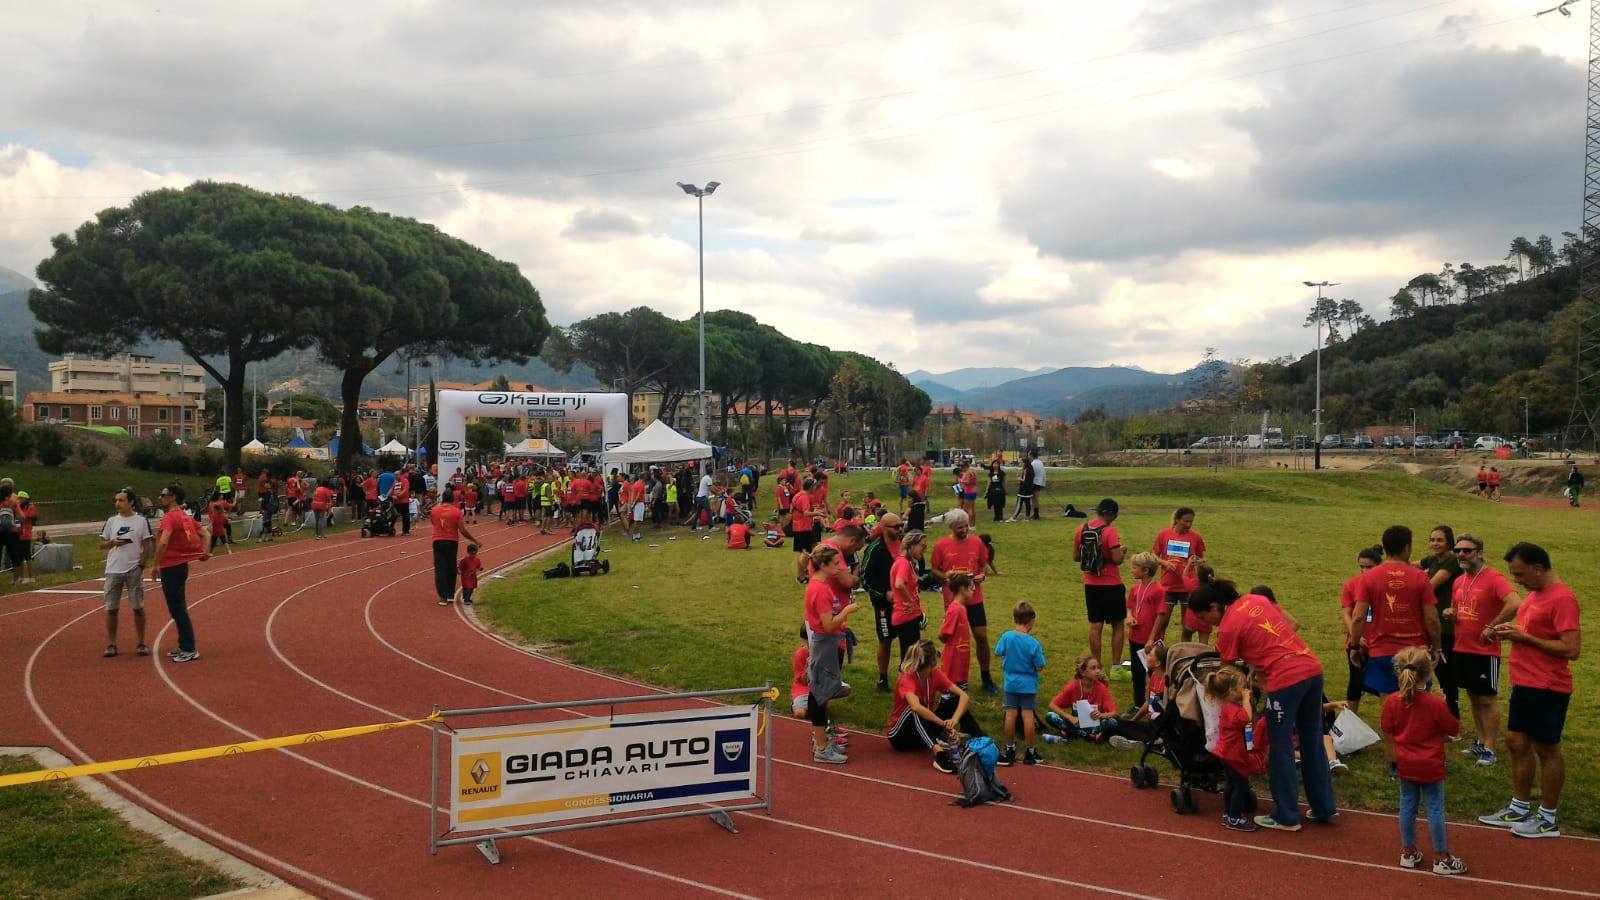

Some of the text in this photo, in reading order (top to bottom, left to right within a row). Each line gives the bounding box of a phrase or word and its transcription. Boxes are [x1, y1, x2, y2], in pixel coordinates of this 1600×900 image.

[511, 394, 586, 410] Kalenji
[506, 737, 710, 774] GIADA AUTO
[565, 762, 658, 780] CHIAVARI
[461, 785, 498, 796] RENAULT
[564, 791, 654, 808] CONCESSIONARIA
